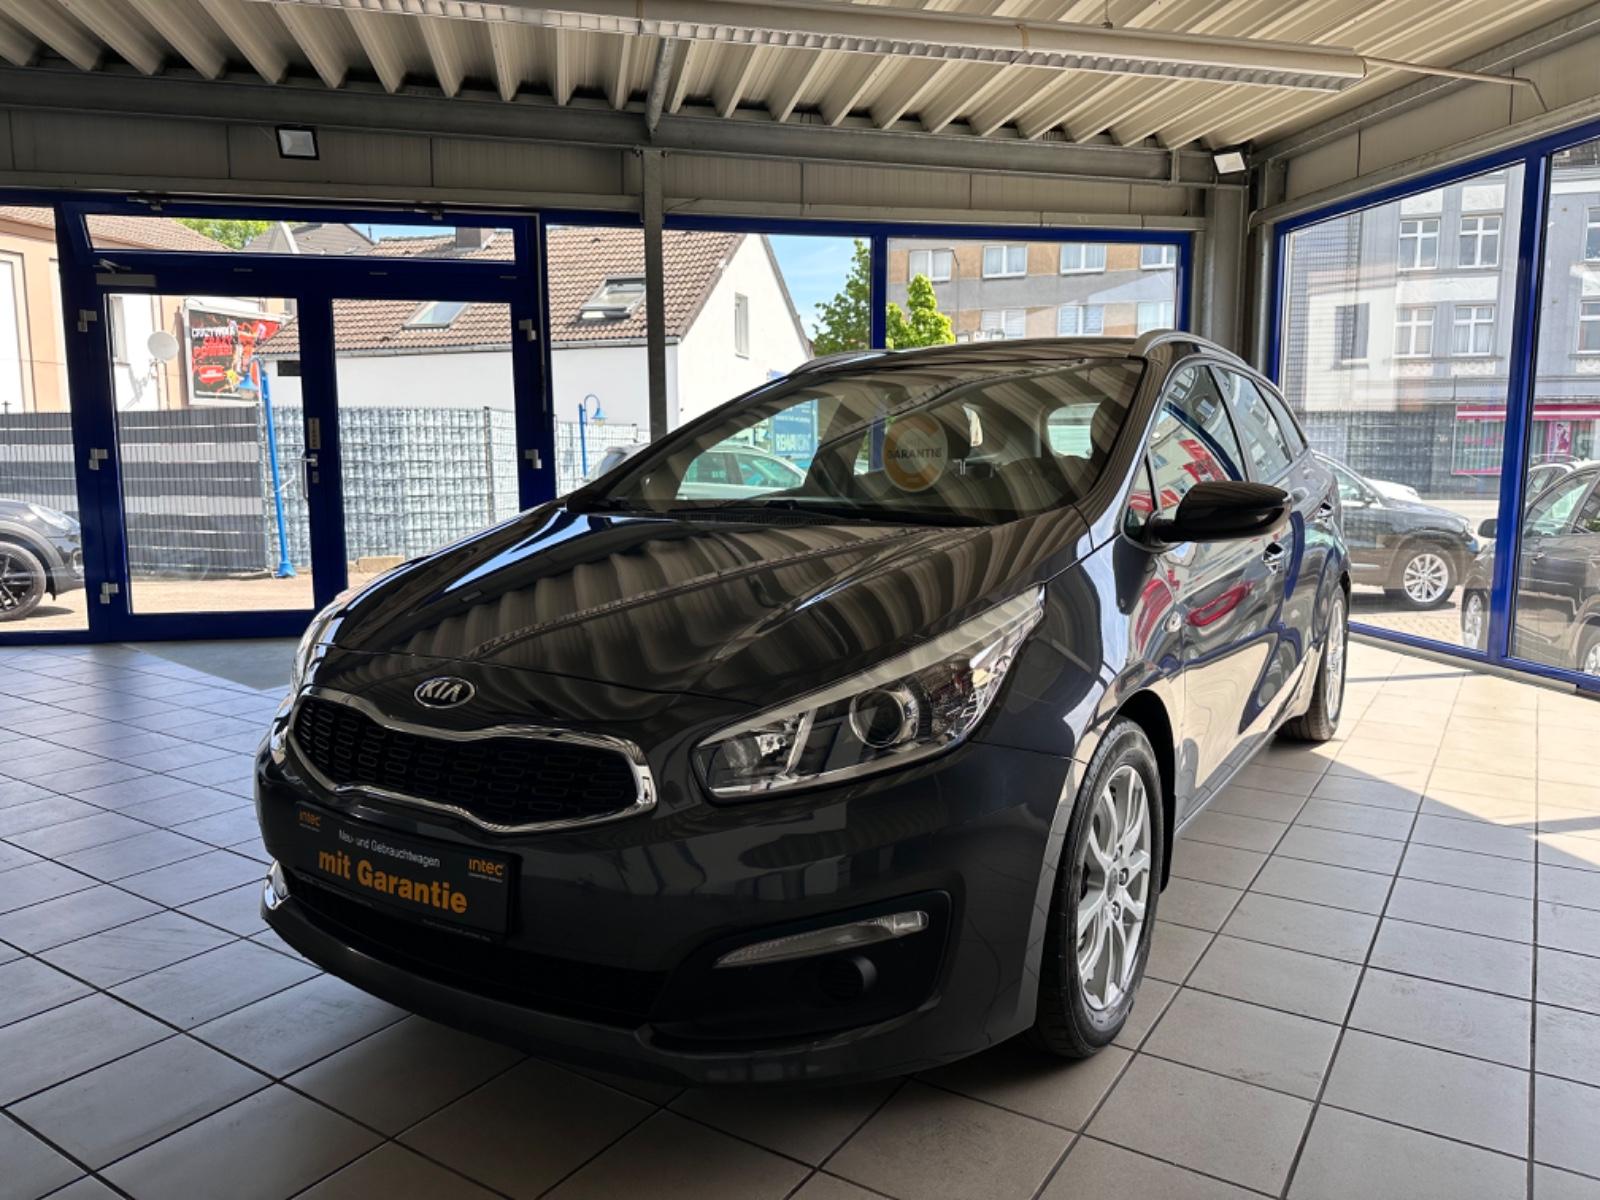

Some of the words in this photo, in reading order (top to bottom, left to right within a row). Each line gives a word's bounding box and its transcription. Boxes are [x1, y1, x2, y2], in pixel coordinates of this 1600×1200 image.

[420, 681, 463, 702] KIA
[299, 810, 320, 828] intec
[356, 838, 370, 849] und
[371, 839, 441, 868] Gebrauchtwagen
[468, 858, 504, 876] intec
[319, 849, 350, 880] mit
[357, 859, 468, 914] Garantie
